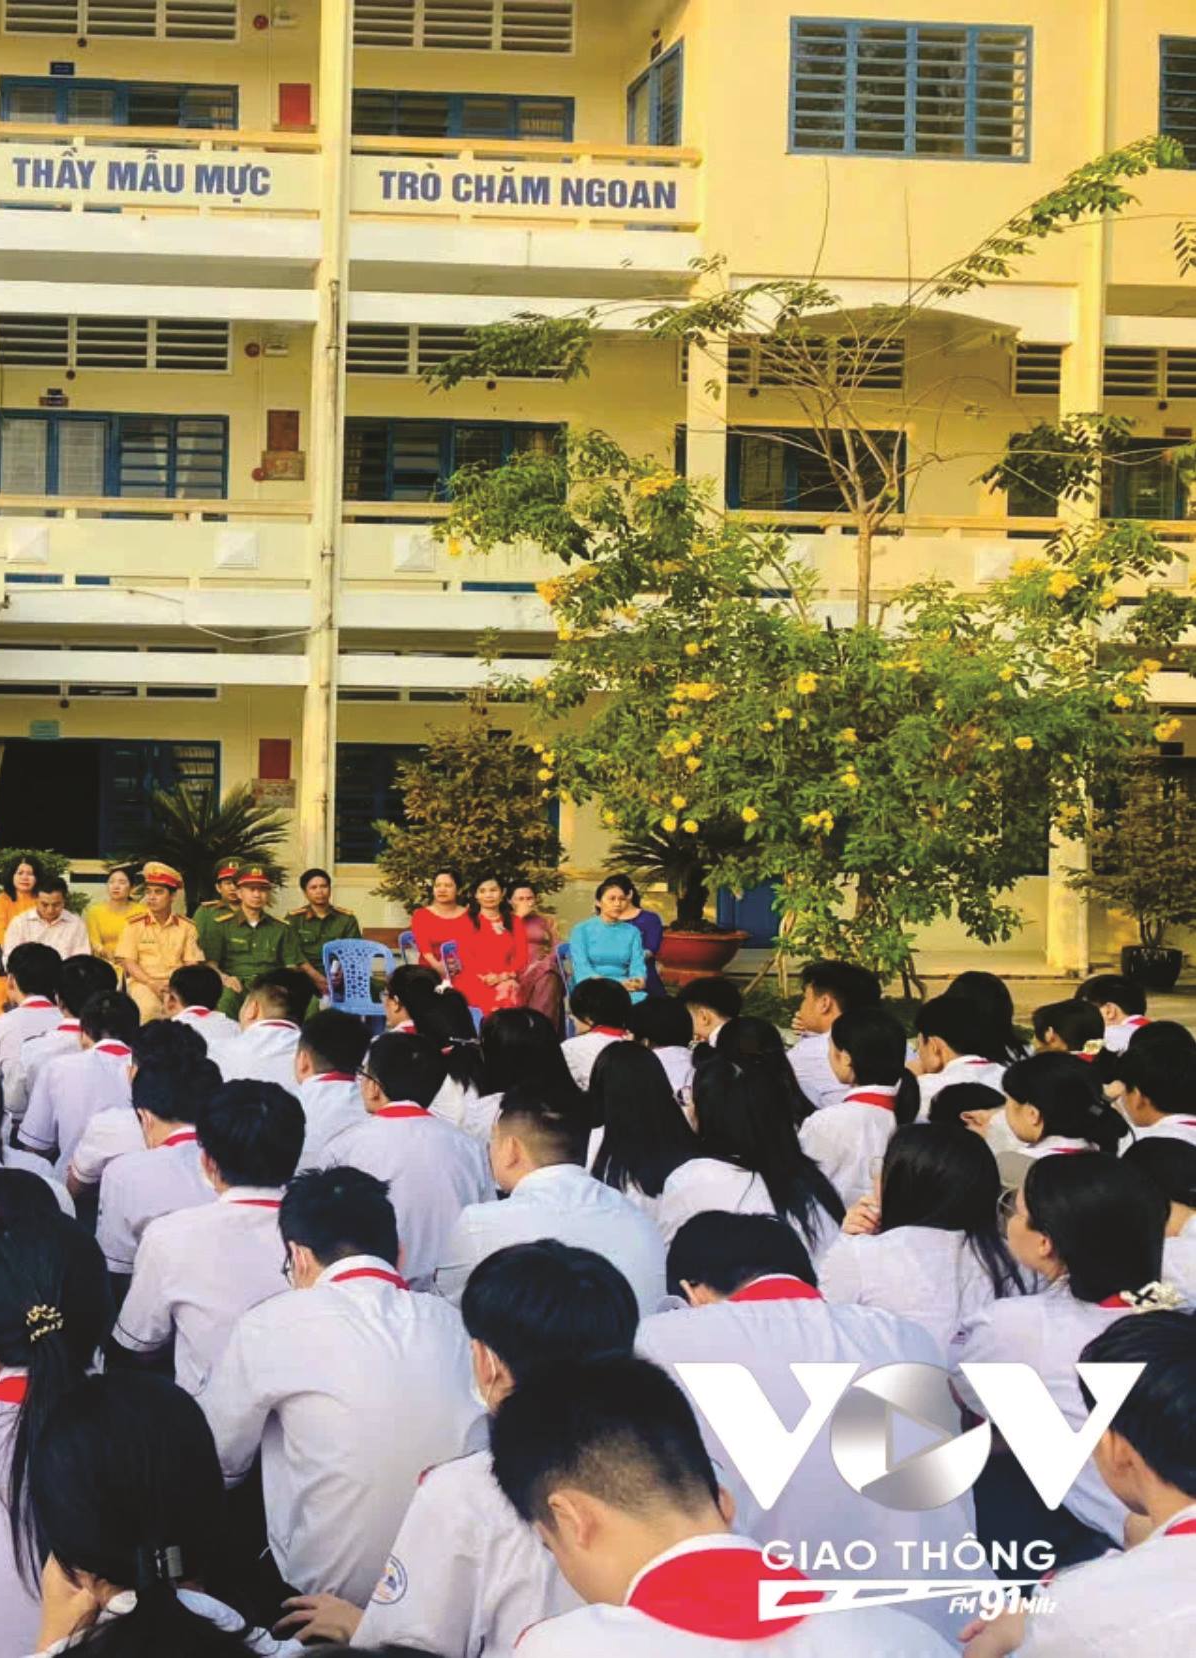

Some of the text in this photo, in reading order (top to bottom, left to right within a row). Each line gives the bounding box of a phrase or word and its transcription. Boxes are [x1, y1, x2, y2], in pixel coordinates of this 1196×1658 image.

[13, 147, 270, 202] THẦY MẪU MỰC
[380, 162, 676, 209] TRÒ CHĂM NGOAN
